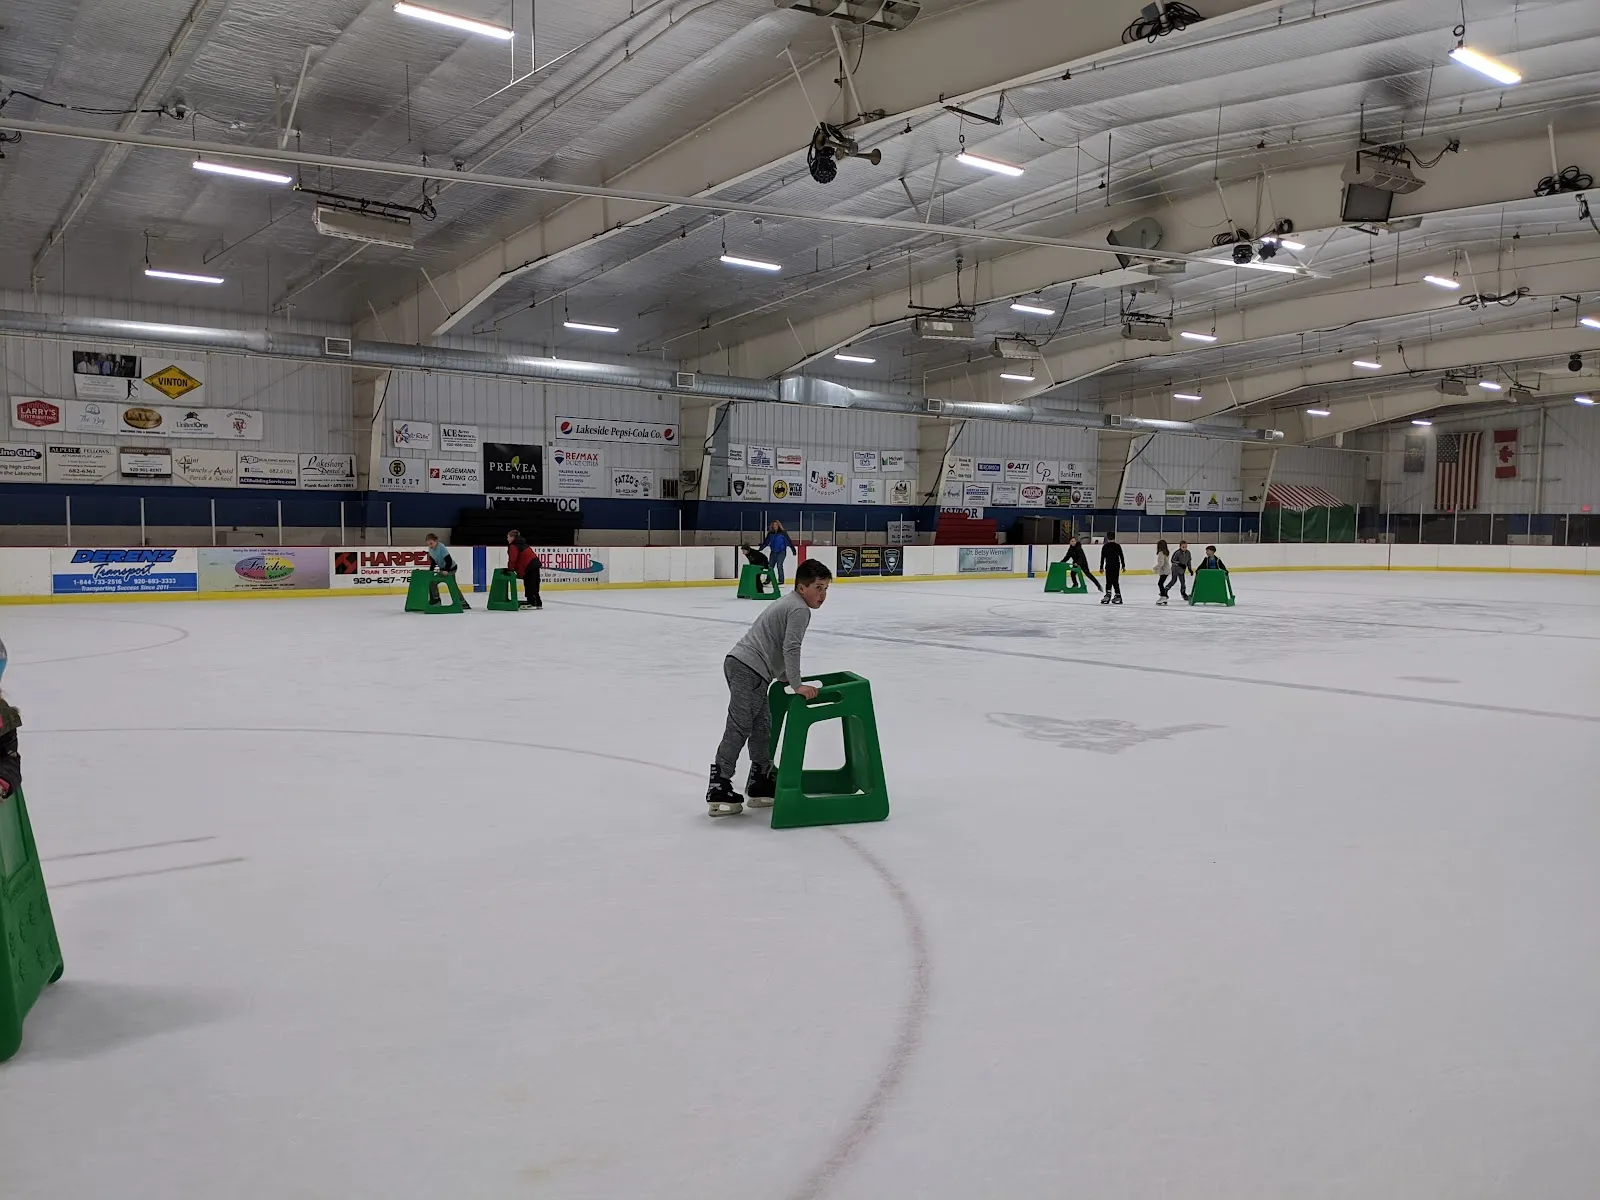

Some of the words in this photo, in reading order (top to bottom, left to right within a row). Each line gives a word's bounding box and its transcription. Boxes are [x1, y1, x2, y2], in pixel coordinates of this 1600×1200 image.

[158, 378, 188, 387] VINTON
[20, 408, 56, 416] LARRY'S
[442, 428, 457, 437] ACE
[576, 425, 610, 436] Lakeside
[611, 428, 649, 439] Pepsi-Cola
[650, 430, 662, 438] Co.
[17, 449, 37, 457] Club
[566, 452, 598, 461] RE/MAX
[489, 461, 538, 473] PREVEA
[942, 508, 978, 518] ISITOR
[70, 550, 177, 563] DERENZ
[360, 552, 431, 566] HARPE
[556, 554, 591, 569] SKATING
[241, 560, 286, 571] Fricke
[93, 562, 155, 581] Transport
